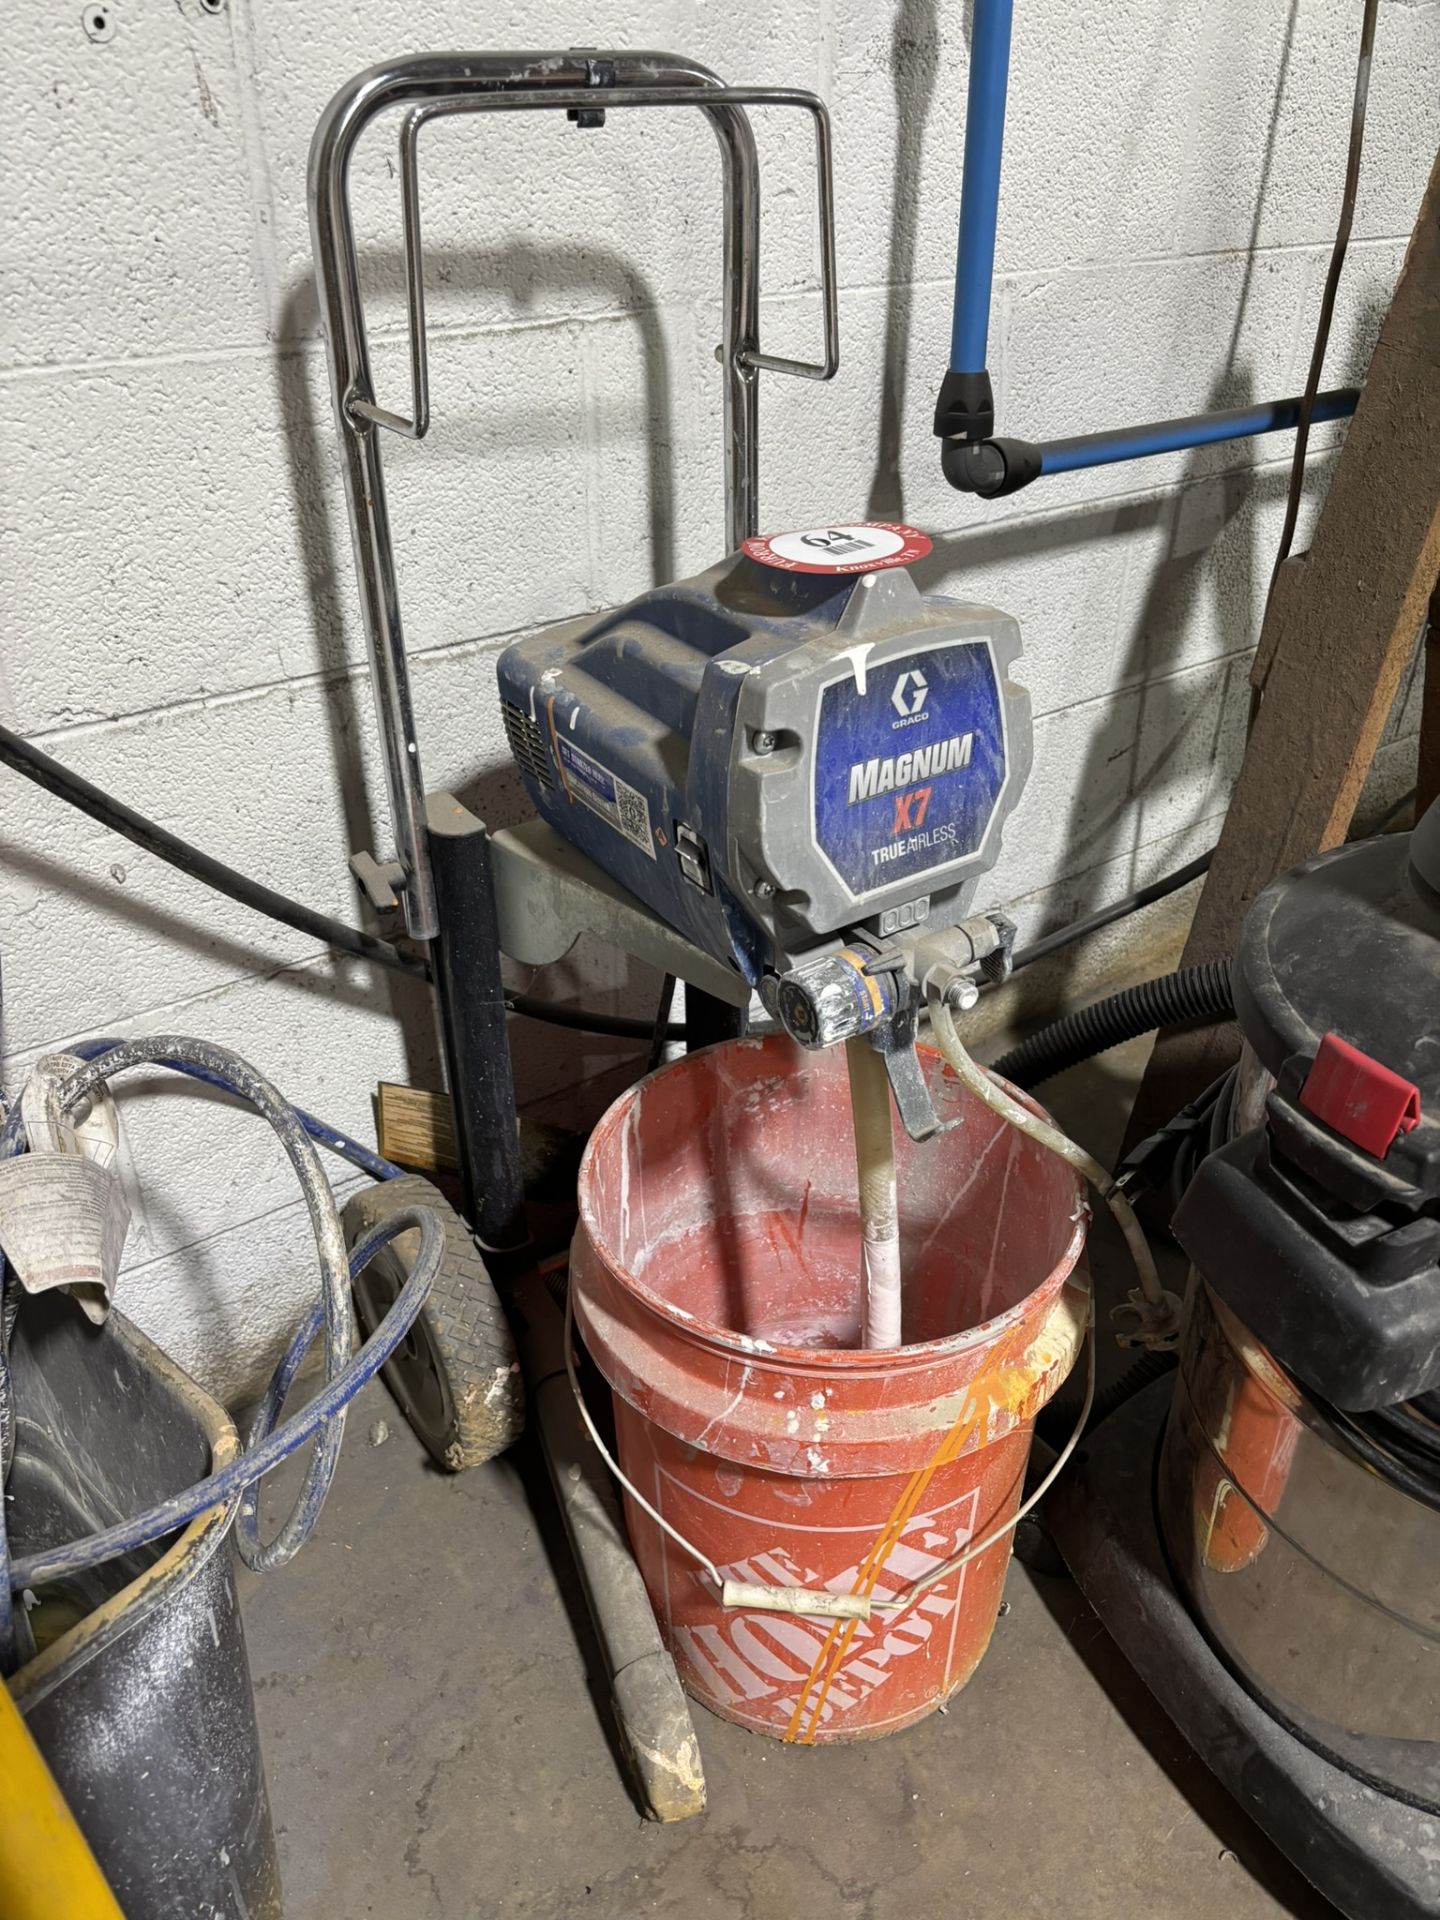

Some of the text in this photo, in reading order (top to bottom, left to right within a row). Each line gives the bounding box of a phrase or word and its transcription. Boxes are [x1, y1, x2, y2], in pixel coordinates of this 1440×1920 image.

[800, 530, 854, 547] 64
[892, 712, 929, 730] GRACO
[892, 786, 932, 834] X7
[772, 1583, 958, 1733] DEPOT
